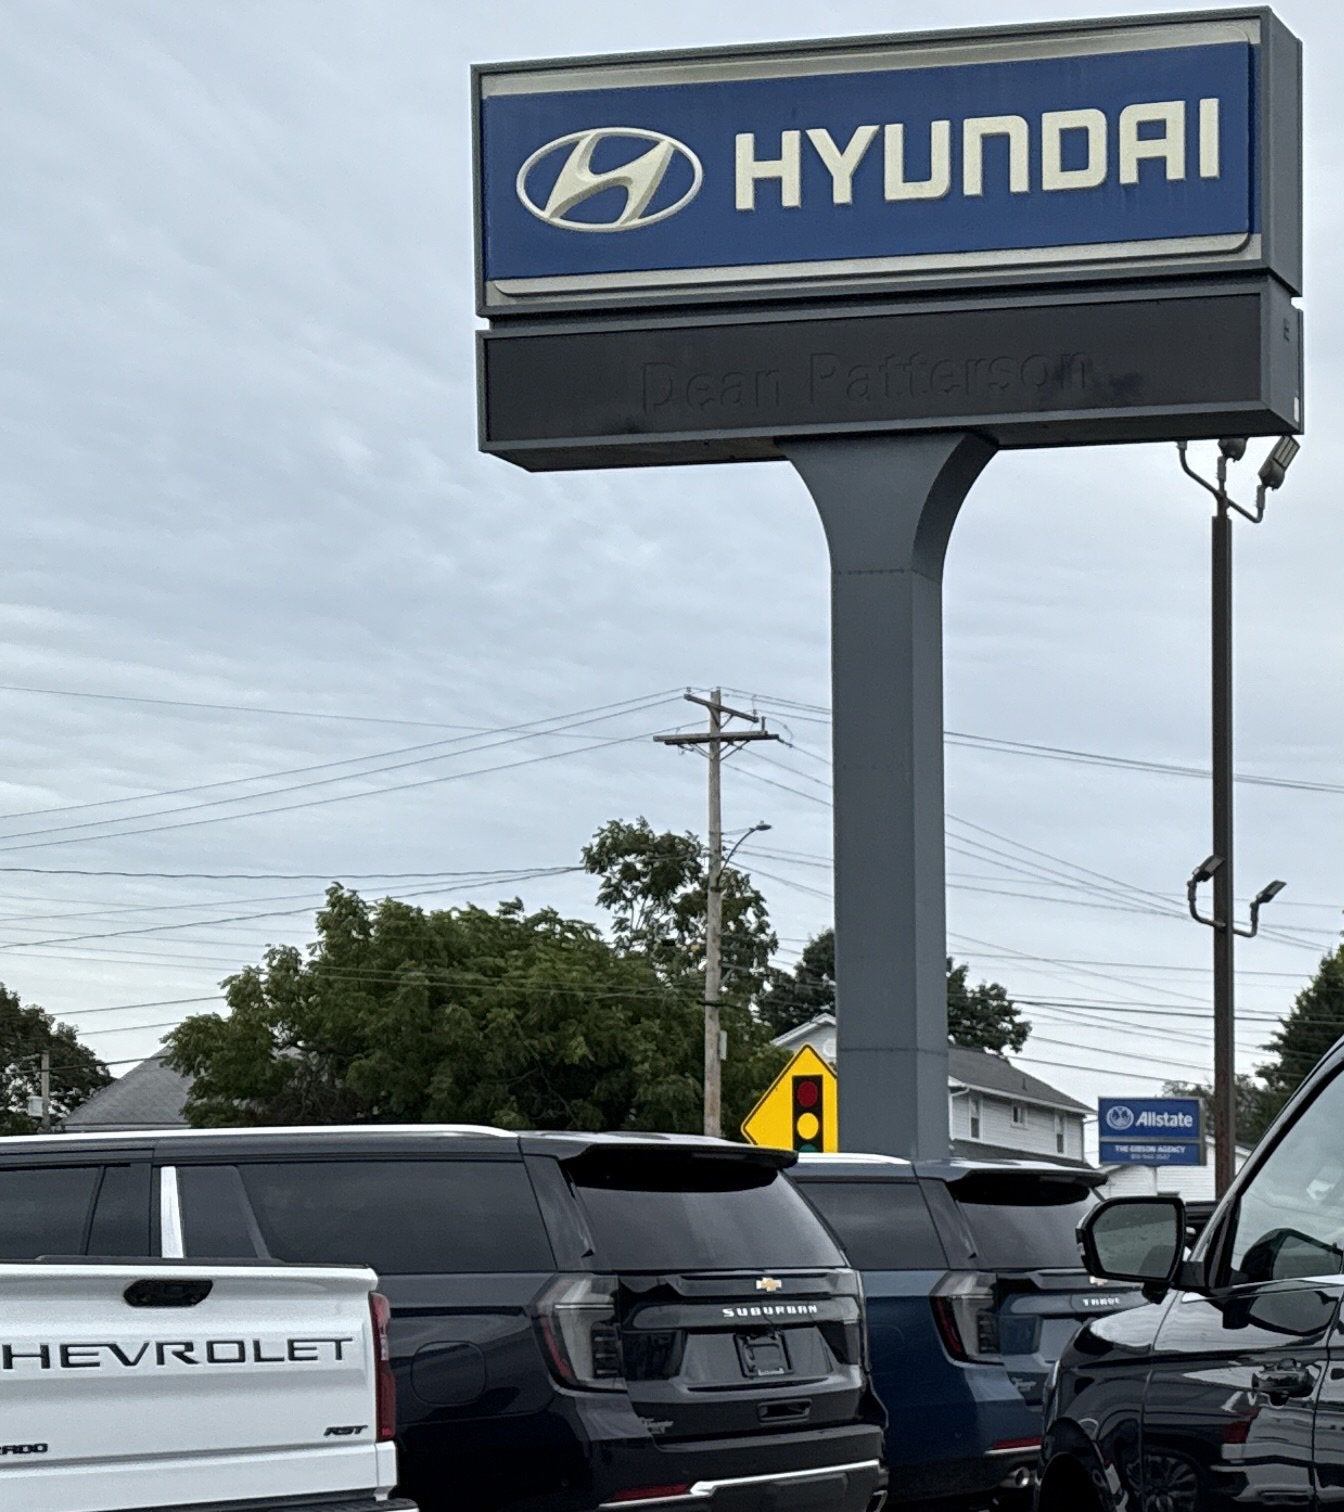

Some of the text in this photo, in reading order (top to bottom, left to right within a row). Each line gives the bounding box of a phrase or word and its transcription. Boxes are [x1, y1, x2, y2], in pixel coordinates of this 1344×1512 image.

[734, 97, 1220, 211] HYUNDAI
[641, 361, 780, 411] Dean
[1135, 1111, 1193, 1128] Allstate
[722, 1304, 818, 1318] SUBURBAN
[323, 1424, 369, 1437] RST
[0, 1443, 48, 1456] ADO
